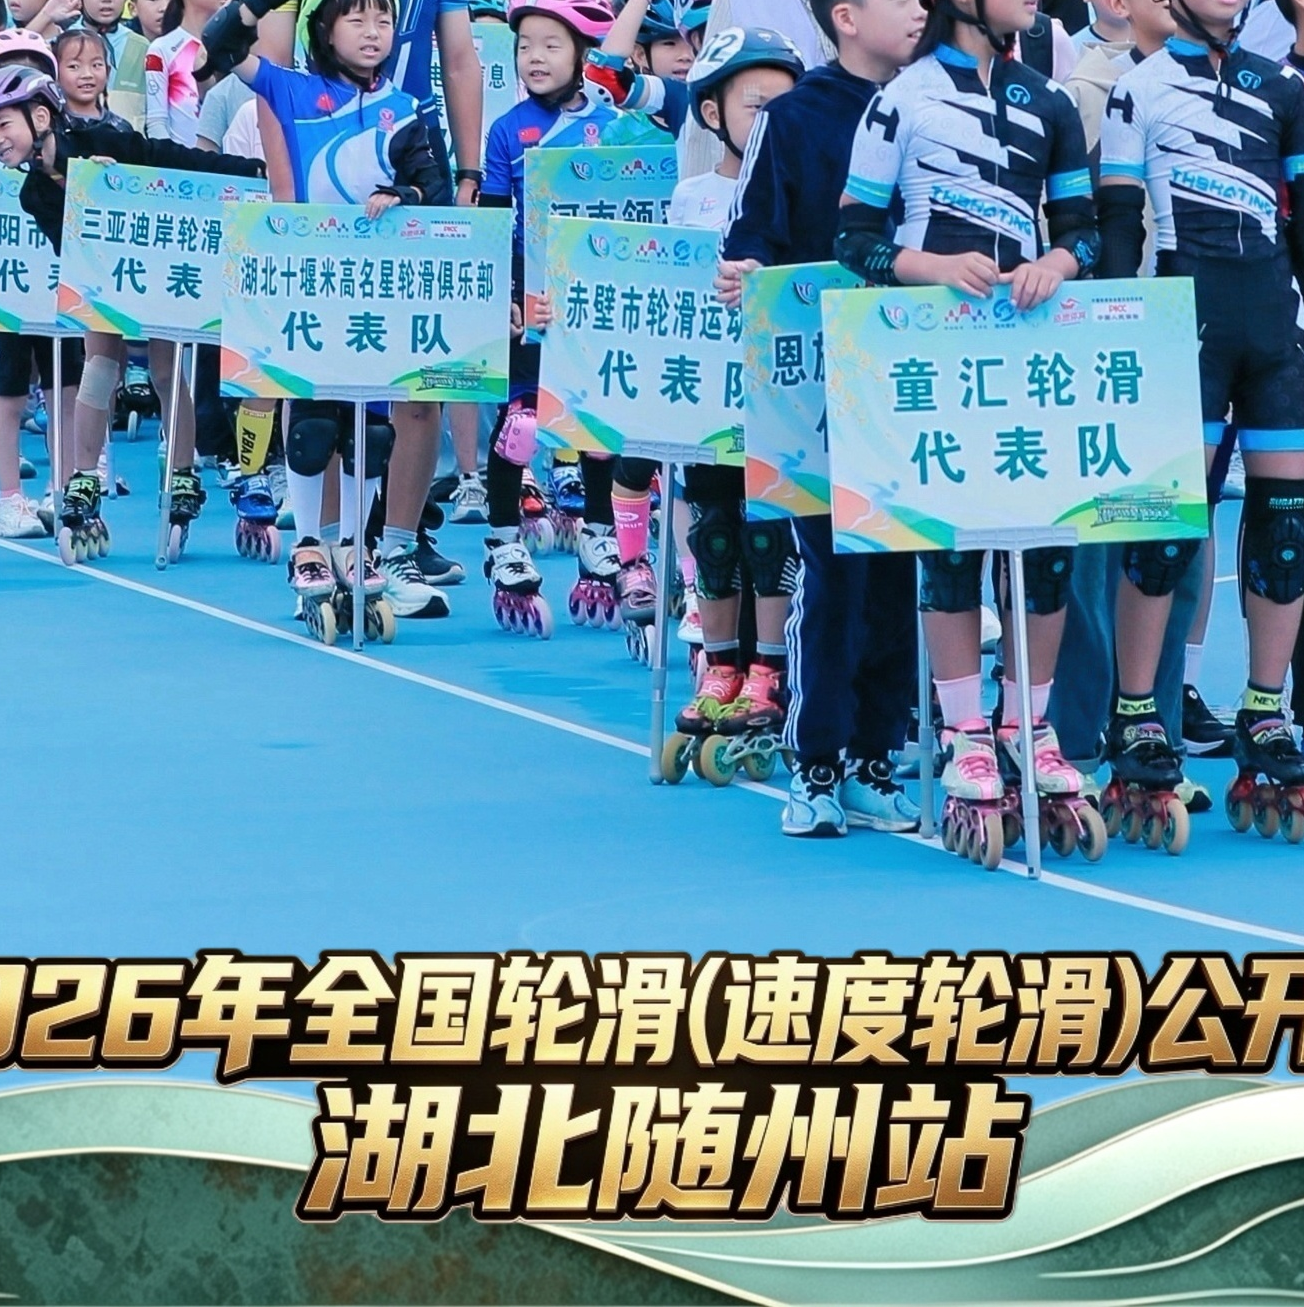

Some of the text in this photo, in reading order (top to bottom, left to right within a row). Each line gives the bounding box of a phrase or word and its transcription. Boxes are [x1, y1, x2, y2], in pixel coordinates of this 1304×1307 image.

[81, 209, 224, 255] 三亚迪岸轮滑
[111, 257, 203, 300] 代表
[241, 256, 494, 302] 湖北十堰米高名星轮滑俱乐部
[282, 311, 452, 355] 代表队
[889, 350, 1144, 412] 童汇轮滑
[911, 423, 1132, 485] 代表队
